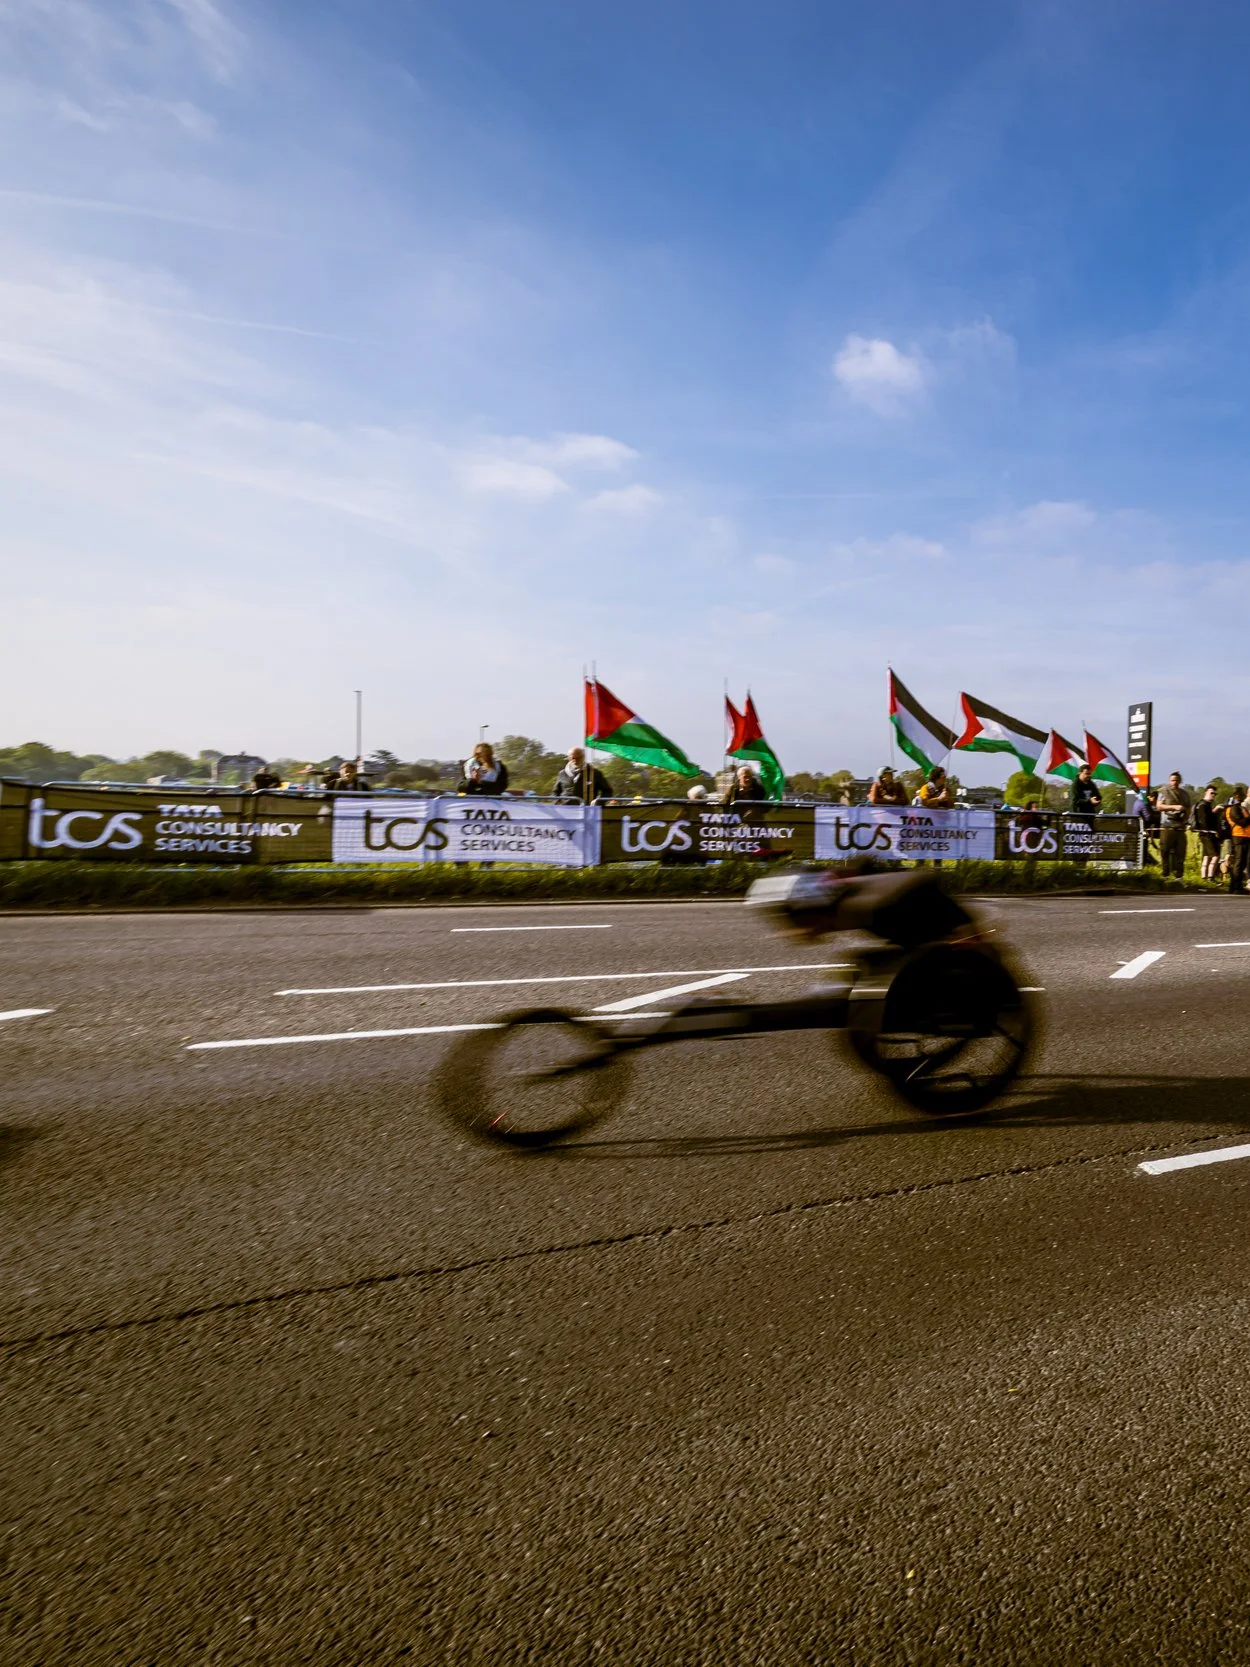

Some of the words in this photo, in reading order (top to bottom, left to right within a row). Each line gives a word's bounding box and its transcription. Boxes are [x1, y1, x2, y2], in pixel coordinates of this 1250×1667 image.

[157, 804, 223, 818] TATA
[462, 808, 511, 821] TATA
[29, 797, 143, 850] tcs
[699, 813, 741, 824] TATA
[900, 815, 933, 826] TATA
[155, 820, 302, 837] CONSULTANCY
[363, 809, 449, 850] tcs
[461, 824, 576, 841] CONSULTANCY
[621, 815, 692, 852] tcs
[699, 826, 795, 839] CONSULTANCY
[834, 816, 892, 850] tcs
[1063, 822, 1092, 832] TATA
[899, 828, 977, 840] CONSULTANCY
[1008, 820, 1058, 853] tcs
[1063, 833, 1126, 843] CONSULTANCY
[154, 837, 252, 854] SERVICES
[460, 840, 536, 852] SERVICES
[699, 840, 761, 853] SERVICES
[899, 841, 949, 851] SERVICES
